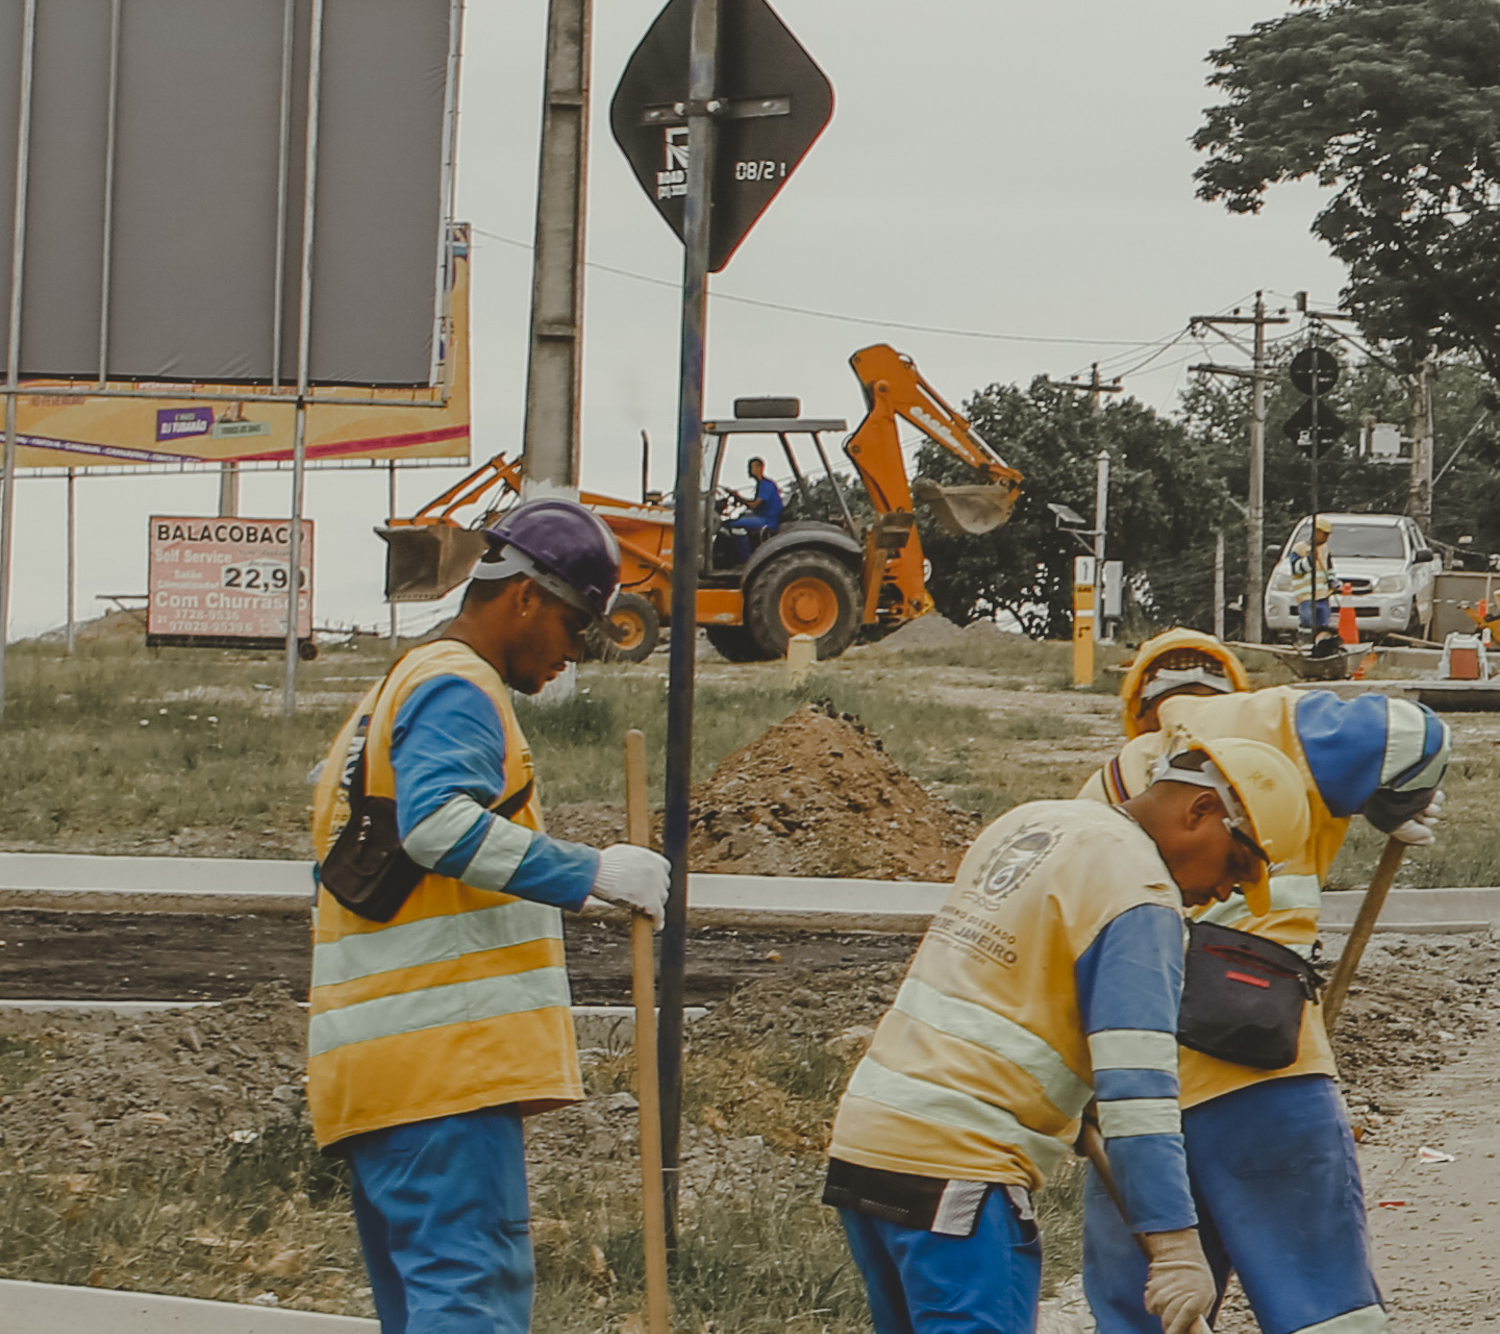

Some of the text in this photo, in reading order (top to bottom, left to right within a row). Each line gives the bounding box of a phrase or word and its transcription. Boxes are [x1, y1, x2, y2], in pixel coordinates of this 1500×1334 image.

[155, 549, 179, 564] Self
[184, 551, 233, 564] Service
[155, 591, 199, 608] Com
[954, 927, 1017, 964] JANEIRO
